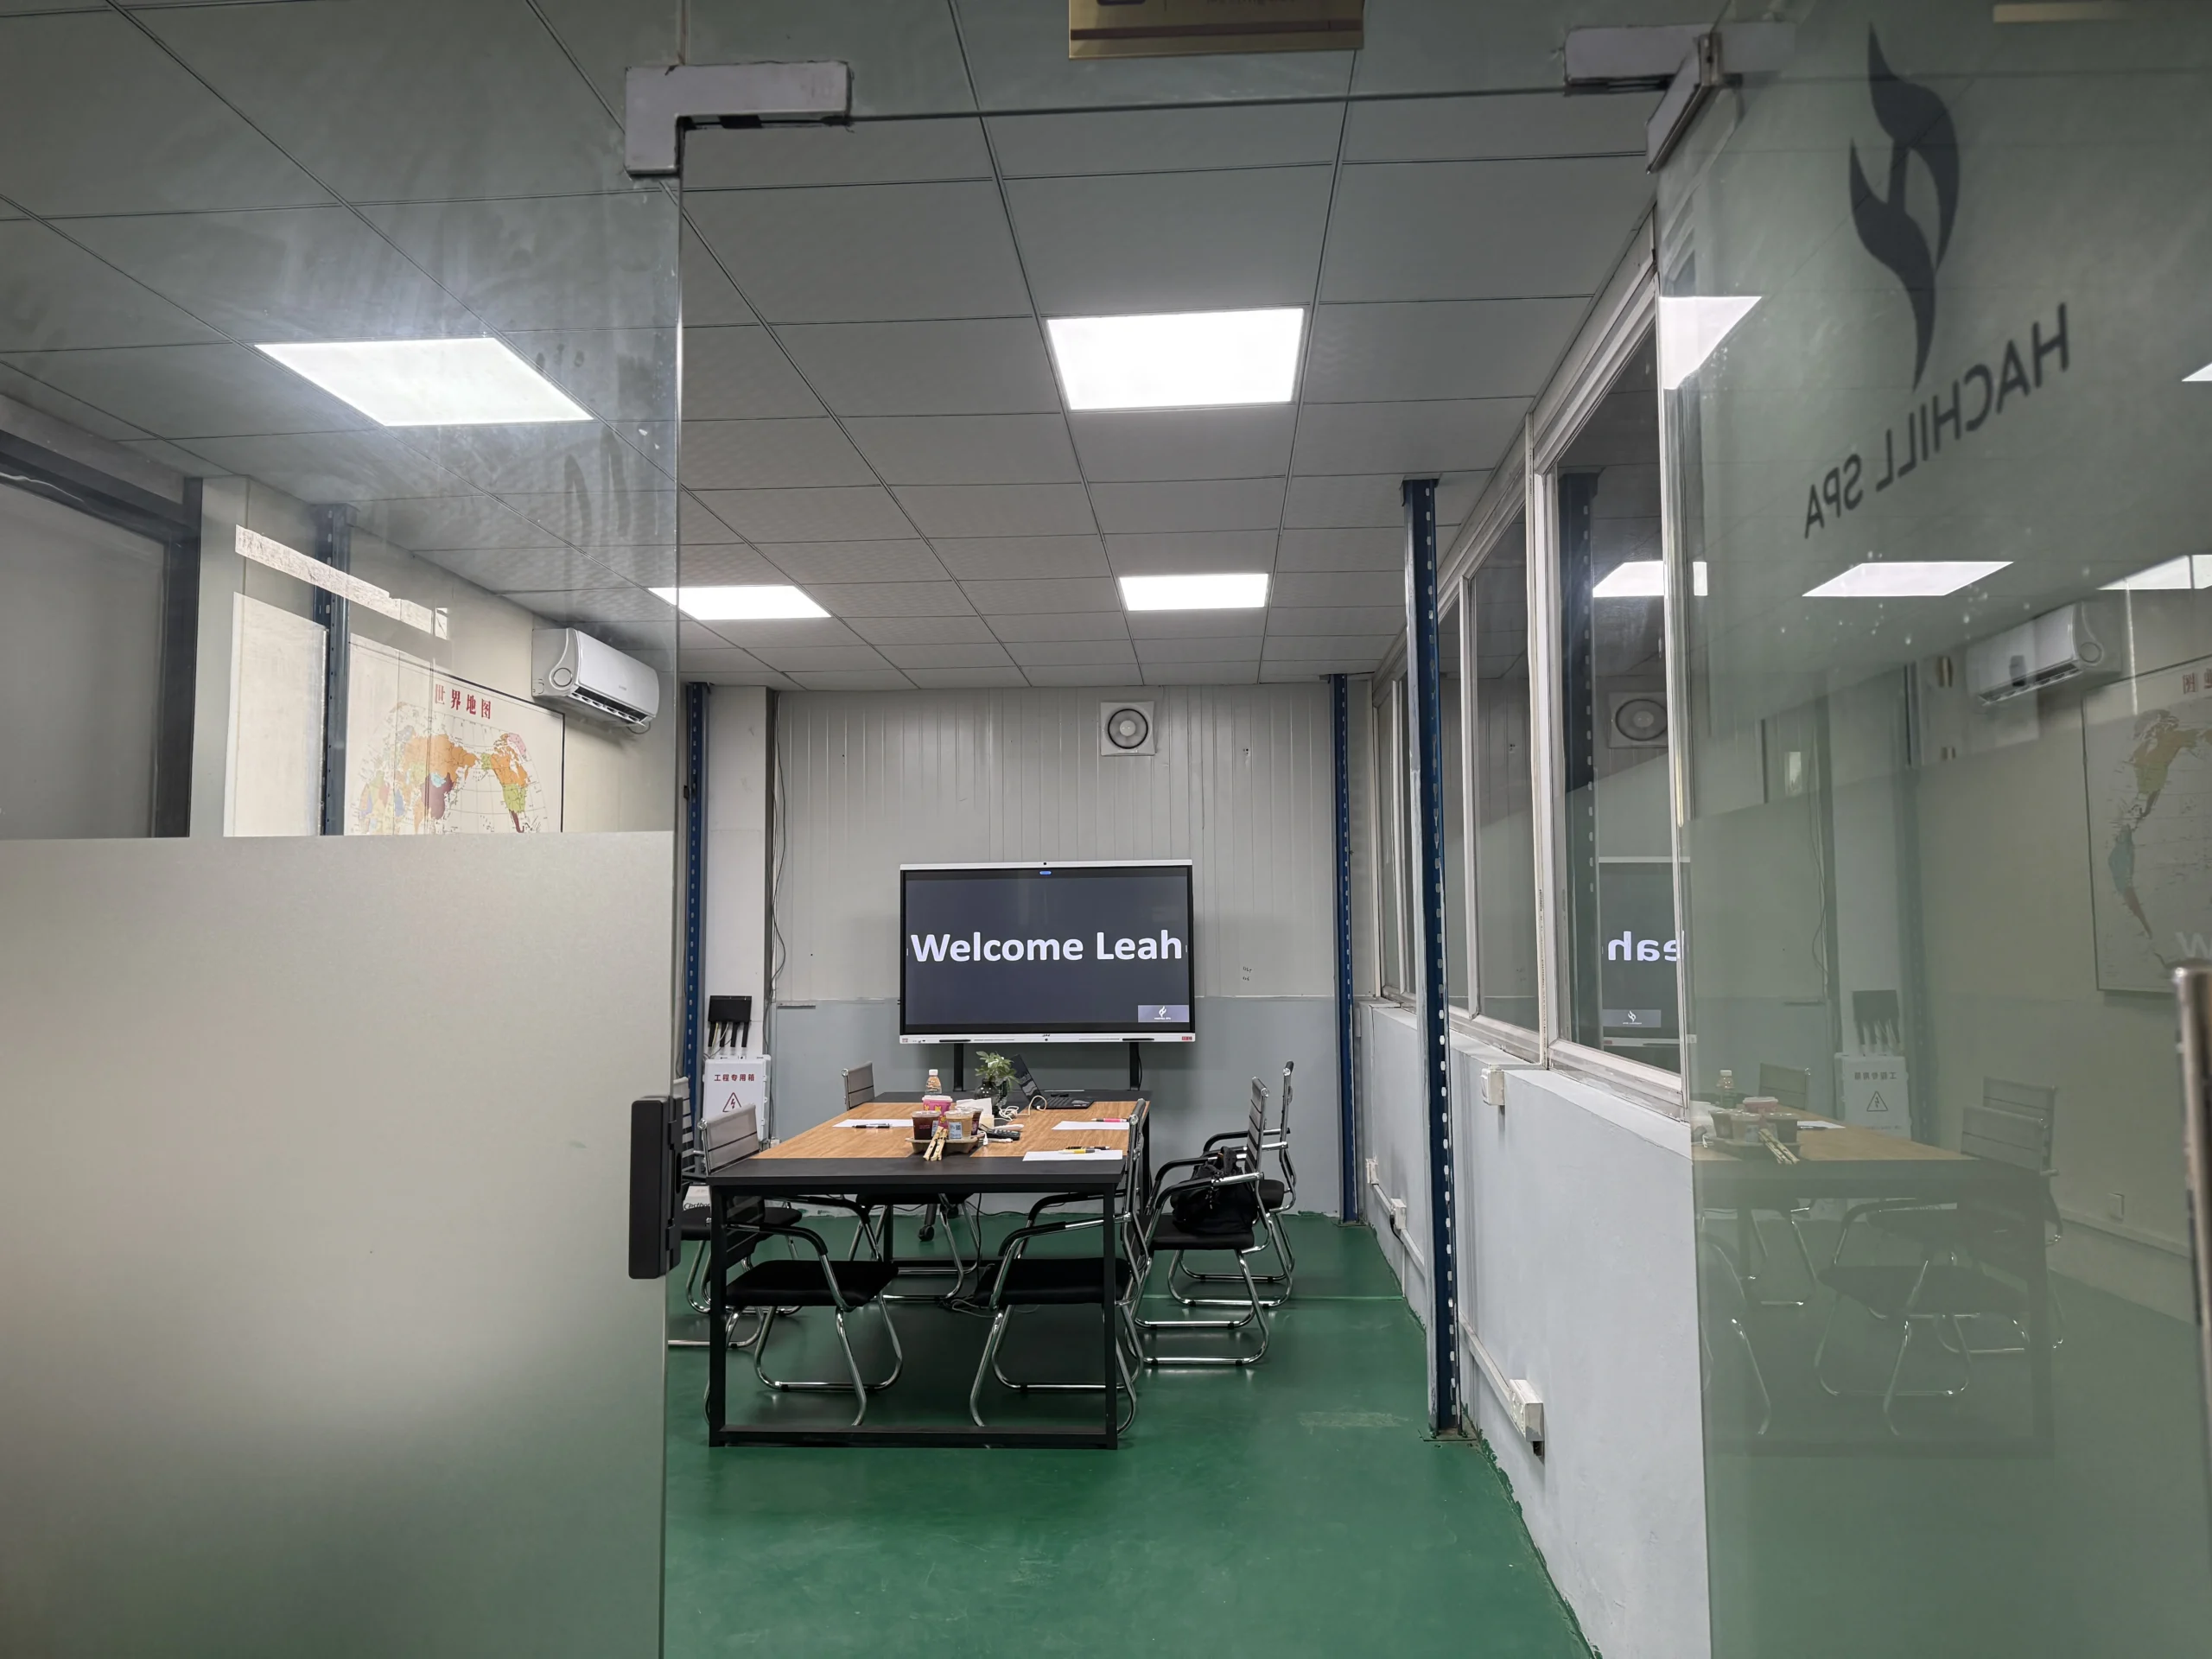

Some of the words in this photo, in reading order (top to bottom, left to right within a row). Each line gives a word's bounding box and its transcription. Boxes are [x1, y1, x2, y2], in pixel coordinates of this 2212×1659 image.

[435, 683, 492, 720] 世界地图
[910, 931, 1084, 963] Welcome
[1096, 929, 1182, 960] Leah
[714, 1073, 755, 1082] 工程专用箱
